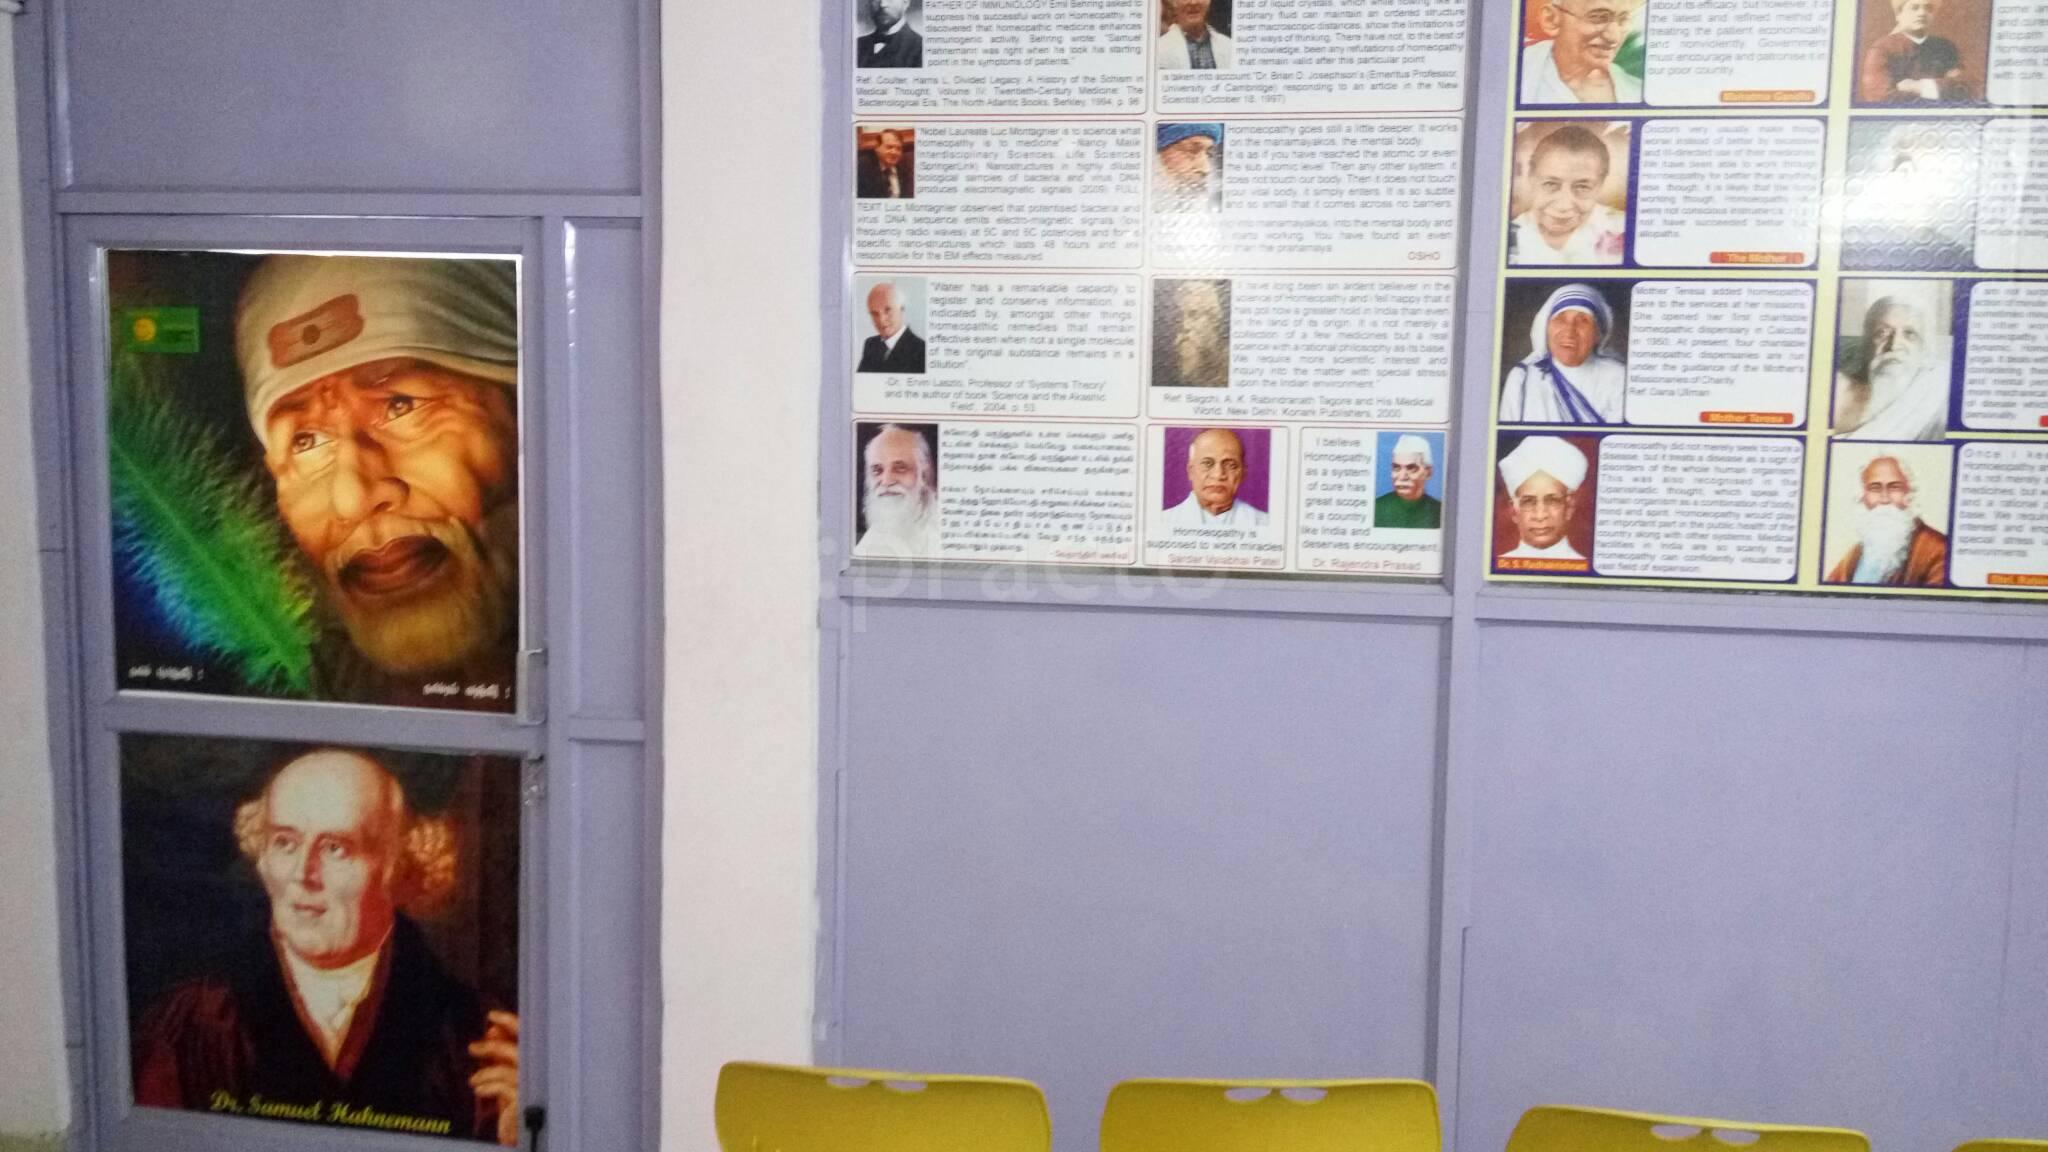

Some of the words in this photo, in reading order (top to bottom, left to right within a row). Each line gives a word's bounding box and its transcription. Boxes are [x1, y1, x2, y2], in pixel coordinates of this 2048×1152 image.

[210, 1089, 244, 1113] Dr.
[248, 1093, 322, 1121] Samuel
[326, 1101, 451, 1134] Hahnemann
